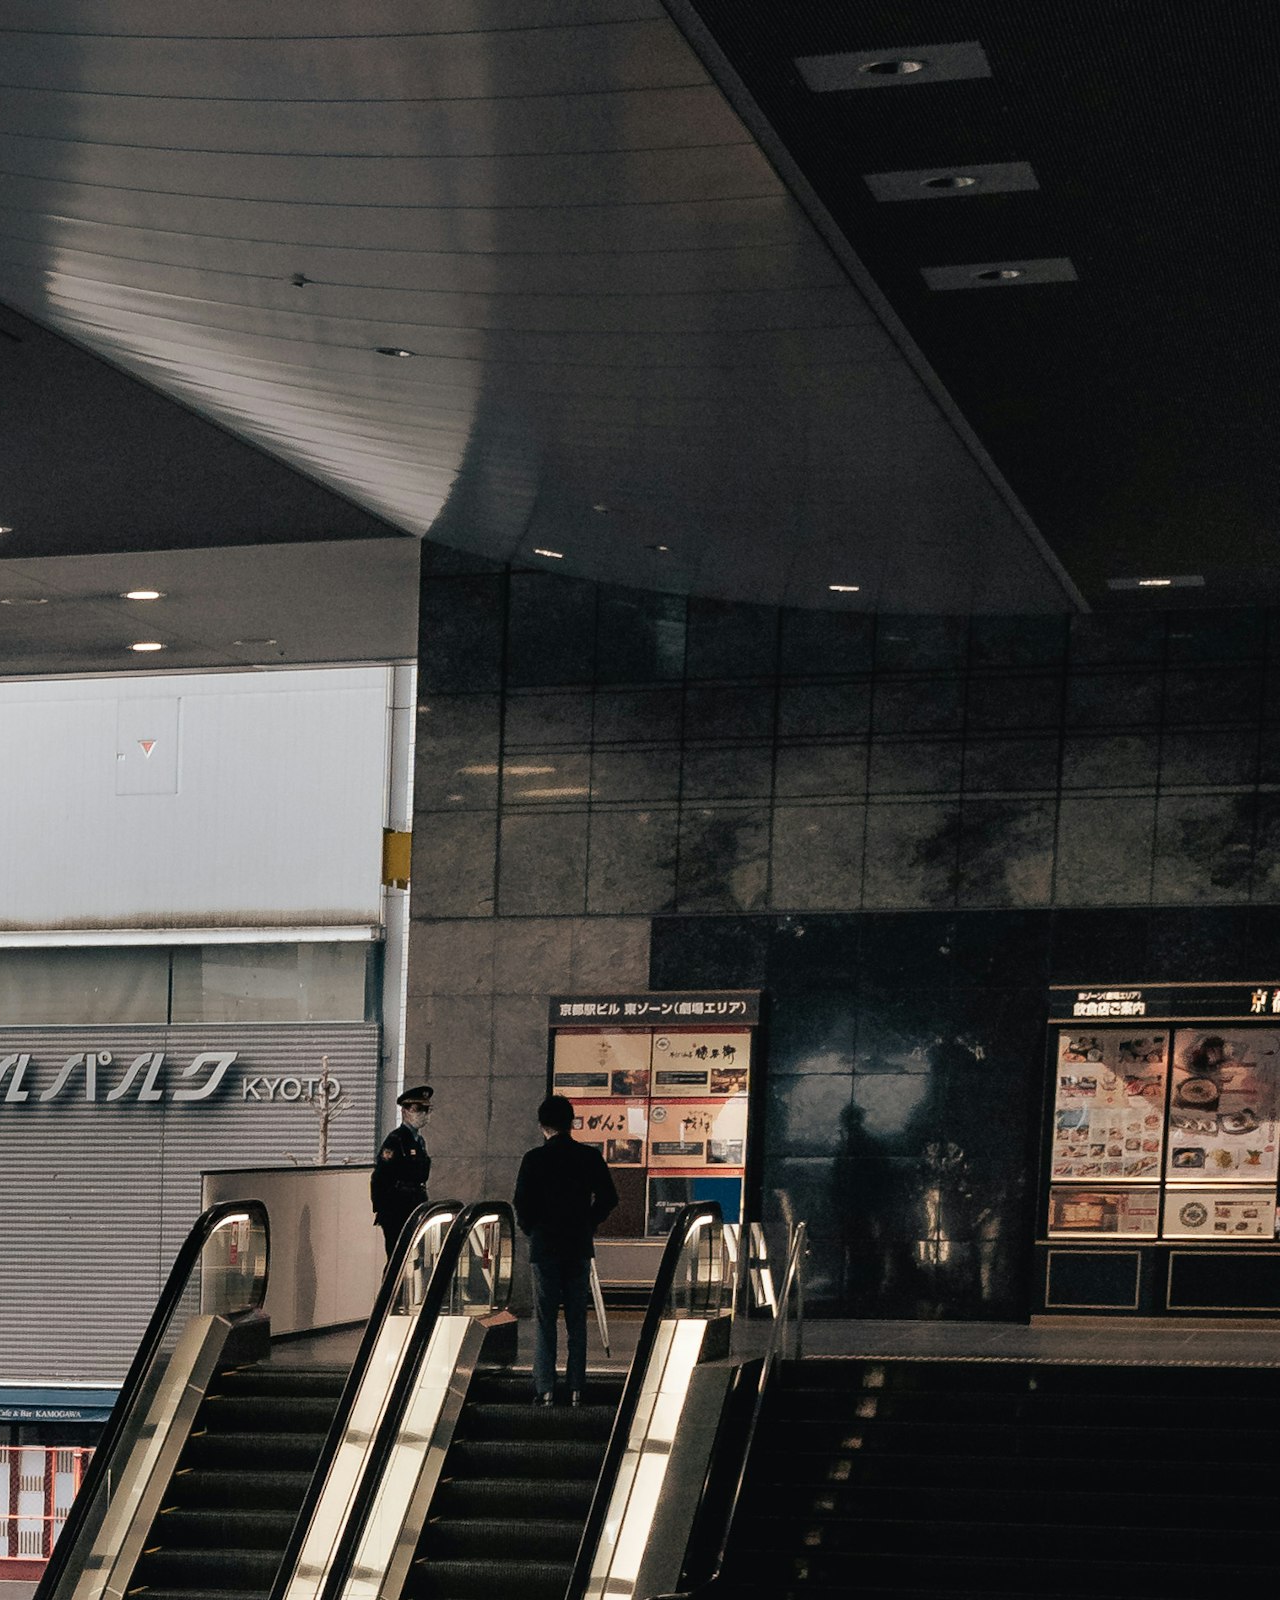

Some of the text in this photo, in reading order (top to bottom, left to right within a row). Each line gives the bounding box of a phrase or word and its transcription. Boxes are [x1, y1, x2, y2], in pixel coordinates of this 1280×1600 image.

[559, 1001, 747, 1016] 京都駅ビル 東ゾーン(劇場エリア)
[1073, 1001, 1146, 1016] 飲食店ご案内
[242, 1076, 342, 1102] KYOTO
[587, 1114, 626, 1131] がんこ
[12, 1410, 19, 1418] &
[20, 1410, 32, 1418] Bar
[35, 1409, 81, 1419] KAMOGAWA
